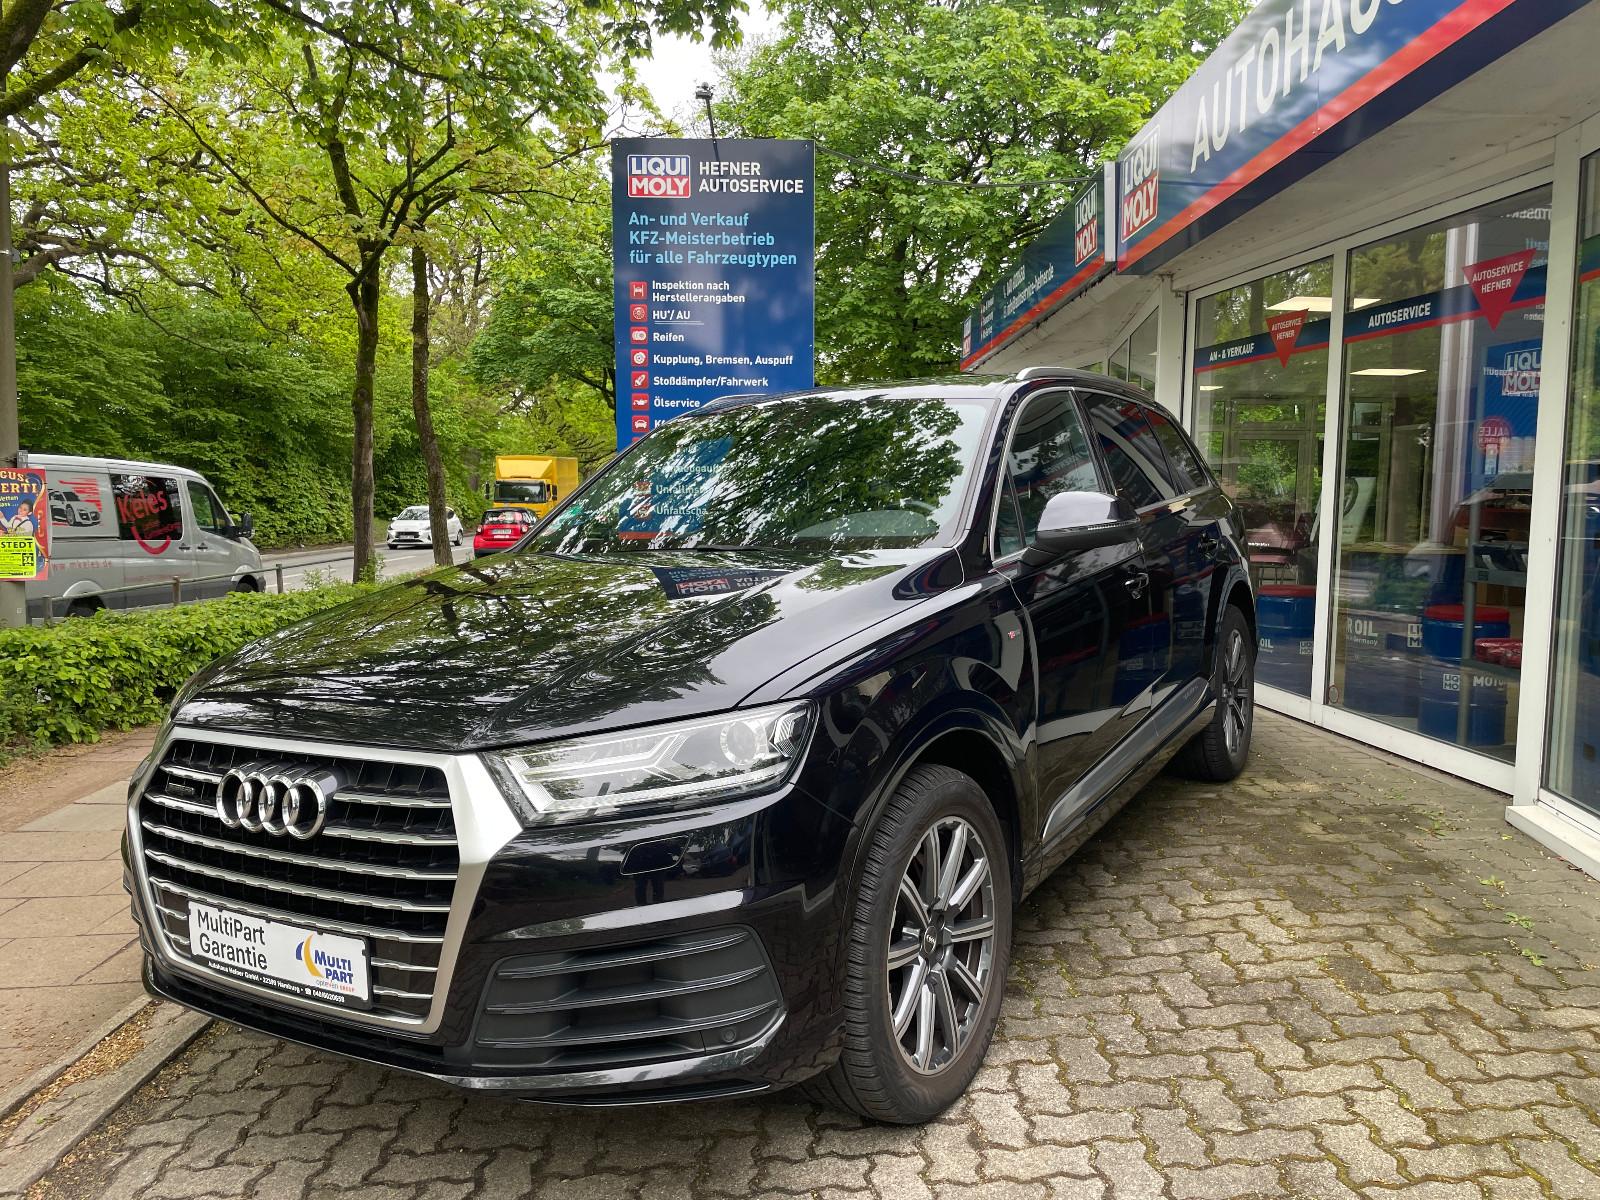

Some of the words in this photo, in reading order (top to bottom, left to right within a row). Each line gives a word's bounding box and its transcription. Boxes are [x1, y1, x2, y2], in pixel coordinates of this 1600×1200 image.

[1191, 0, 1400, 173] AUTOHA
[631, 157, 687, 176] LIQUI
[699, 161, 760, 176] HEFNER
[1124, 131, 1158, 193] LIQUI
[631, 177, 688, 195] MOLY
[699, 179, 804, 194] AUTOSERVICE
[1076, 187, 1095, 231] LIQUI
[1123, 176, 1157, 237] MOLY
[629, 212, 655, 225] An-
[660, 213, 686, 226] und
[691, 213, 749, 226] Verkauf
[630, 231, 775, 246] KFZ-Meisterbetrieb
[1076, 220, 1096, 261] MOLY
[630, 251, 651, 264] für
[656, 251, 683, 264] alle
[688, 251, 797, 267] Fahrzeugtypen
[1472, 261, 1524, 283] AUTOSERVICE
[652, 280, 703, 292] Inspektion
[707, 281, 729, 291] nach
[1481, 279, 1512, 294] HEFNER
[653, 293, 745, 304] Herstellerangaben
[677, 311, 691, 320] AU
[1368, 302, 1431, 328] AUTOSERVICE
[1271, 318, 1302, 331] AUTOSERVICE
[653, 333, 684, 342] Reifen
[1277, 330, 1295, 340] HEFNER
[1227, 343, 1255, 358] VERKAUF
[654, 355, 703, 366] Kupplung,
[706, 355, 752, 365] Bremsen,
[755, 355, 793, 366] Auspuff
[1507, 352, 1541, 371] LIQU
[654, 376, 768, 387] Stoßdämpfer/Fahrwerk
[1505, 374, 1540, 392] MOL
[654, 395, 700, 407] Ölservice
[115, 490, 167, 524] Keles
[1355, 619, 1378, 637] OIL
[198, 909, 265, 946] MultiPart
[200, 933, 268, 970] Garantie
[315, 950, 351, 971] MULTI
[325, 968, 353, 984] PART
